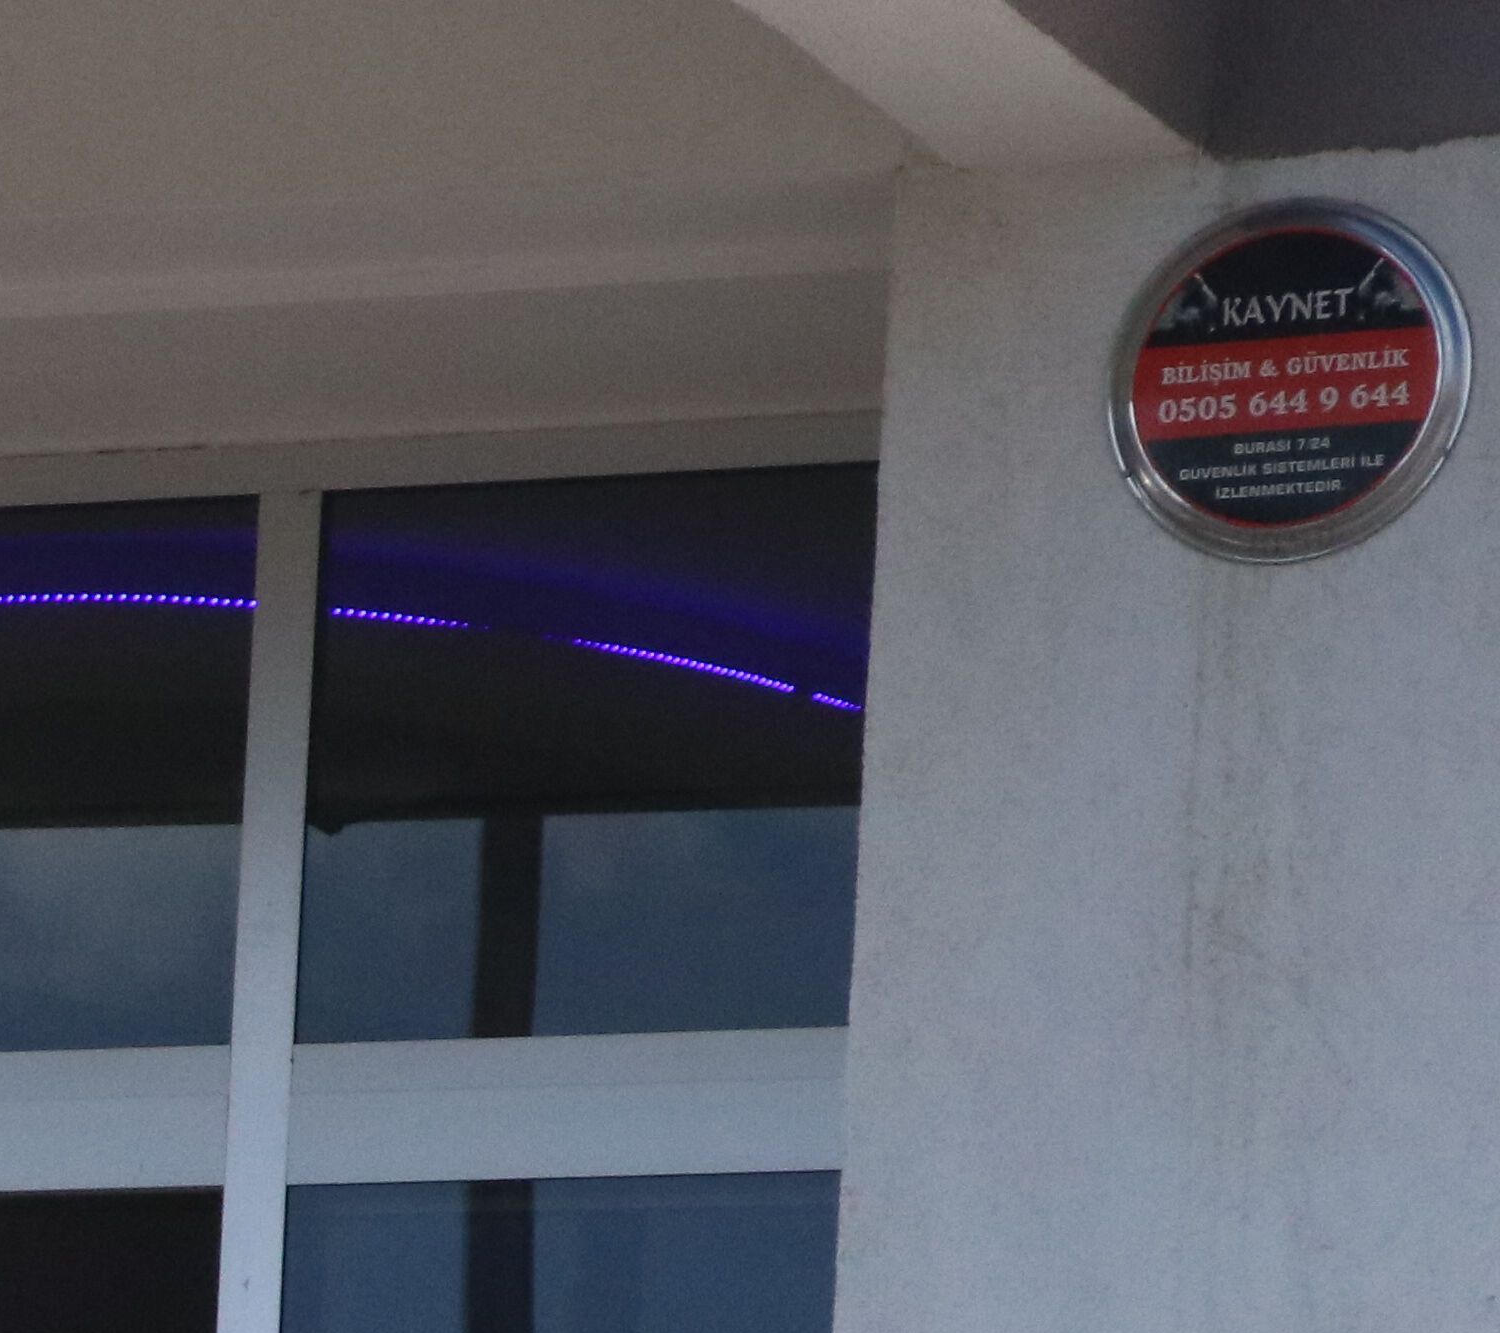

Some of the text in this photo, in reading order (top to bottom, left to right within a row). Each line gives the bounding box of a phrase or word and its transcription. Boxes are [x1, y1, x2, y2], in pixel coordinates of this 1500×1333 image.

[1222, 287, 1355, 327] KAYNET
[1160, 344, 1410, 387] BİLİŞİM & GÜVENLİK
[1158, 380, 1411, 424] 0505 644 9 644
